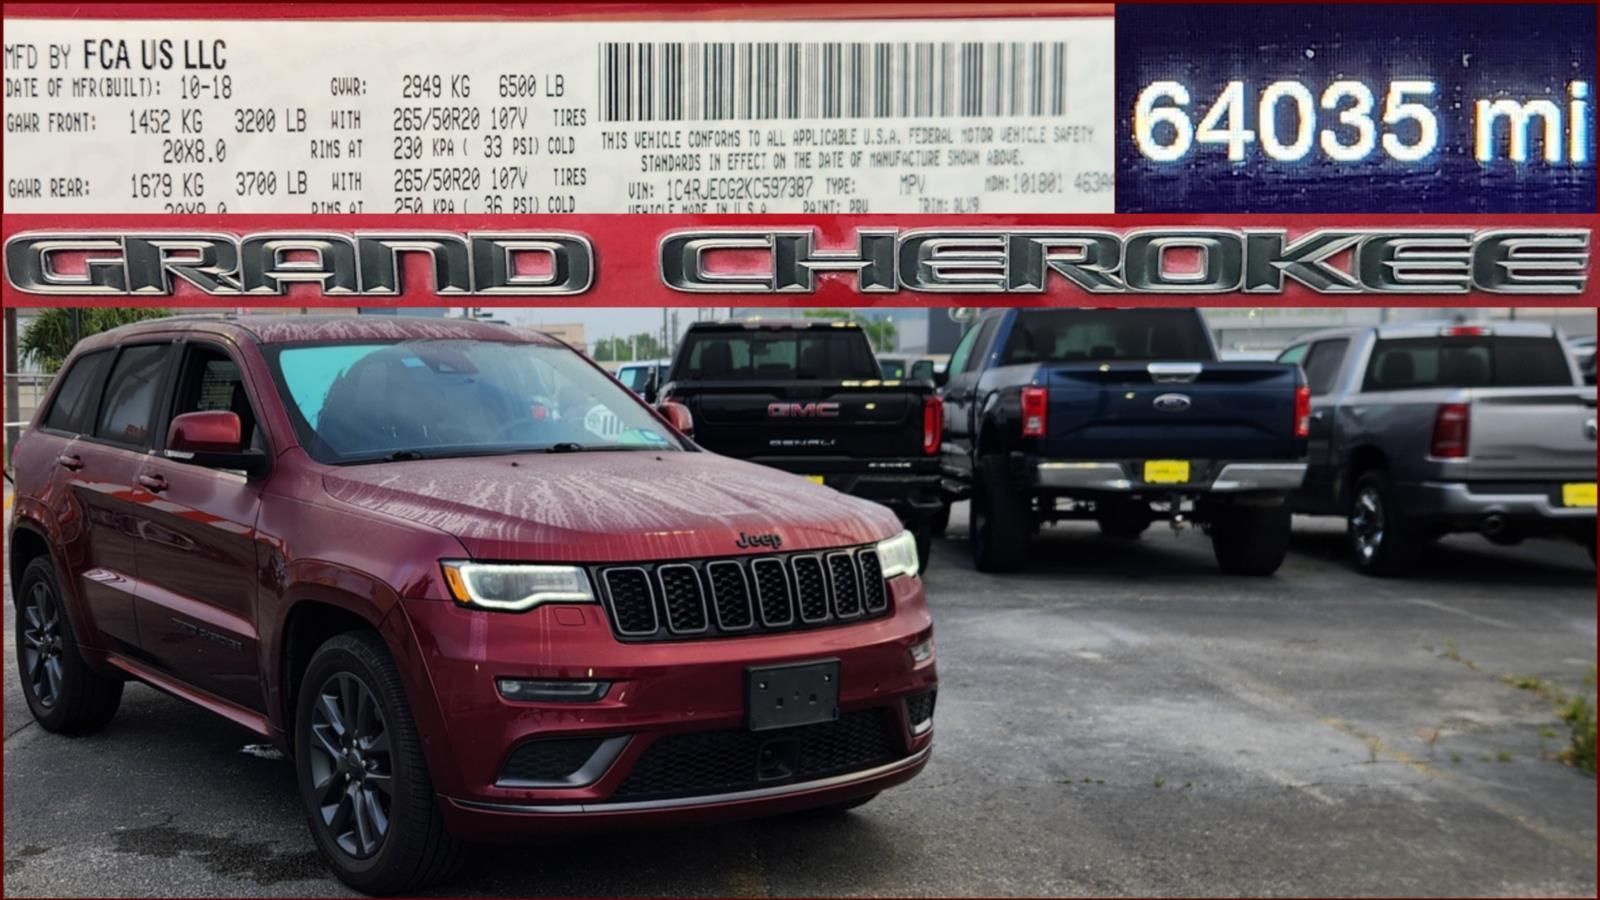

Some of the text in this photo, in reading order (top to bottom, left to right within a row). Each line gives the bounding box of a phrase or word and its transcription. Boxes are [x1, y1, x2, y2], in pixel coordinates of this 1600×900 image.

[4, 39, 227, 69] MFD BY FCA US LLC
[6, 75, 232, 99] DATE OF MFR(BUILT): 10-18
[331, 74, 564, 98] GVWR: 2949 KG 6500 LB
[7, 107, 587, 134] GAWR FRONT: 1452 KG 3200 LB WITH 265/50R20 107V TIRES
[1133, 80, 1589, 162] 64035 mi
[163, 138, 226, 163] 20X8.0
[311, 140, 340, 159] RIMS
[349, 139, 363, 158] AT
[394, 136, 422, 160] 230
[432, 138, 454, 157] KPA
[484, 135, 502, 158] 33
[513, 136, 539, 156] PSI)
[548, 136, 575, 154] COLD
[602, 125, 1094, 150] THIS VEHICLE CONFORMS TO ALL APPLICABLE U.S.A. FEDERAL MOTOR VEHICLE SAFETY
[641, 149, 1024, 172] STANDARDS IN EFFECT ON THE DATE OF MANUFACTURE SHOWN ABOVE.
[9, 167, 587, 198] GAWR REAR: 1679 KG 3700 LB WITH 265/50R20 107V TIRES
[628, 182, 654, 200] VIN:
[667, 176, 813, 201] 1C4RJECG2KC597387
[826, 177, 856, 195] TYPE:
[900, 174, 926, 195] MPV
[311, 201, 341, 214] RIMS
[394, 197, 423, 214] 250
[433, 198, 454, 214] KPA
[484, 195, 502, 214] 36
[513, 196, 539, 214] PSI)
[548, 196, 575, 213] COLD
[4, 228, 1591, 296] GRAND CHEROKEE
[768, 402, 840, 417] GMC
[736, 532, 783, 550] Jeep
